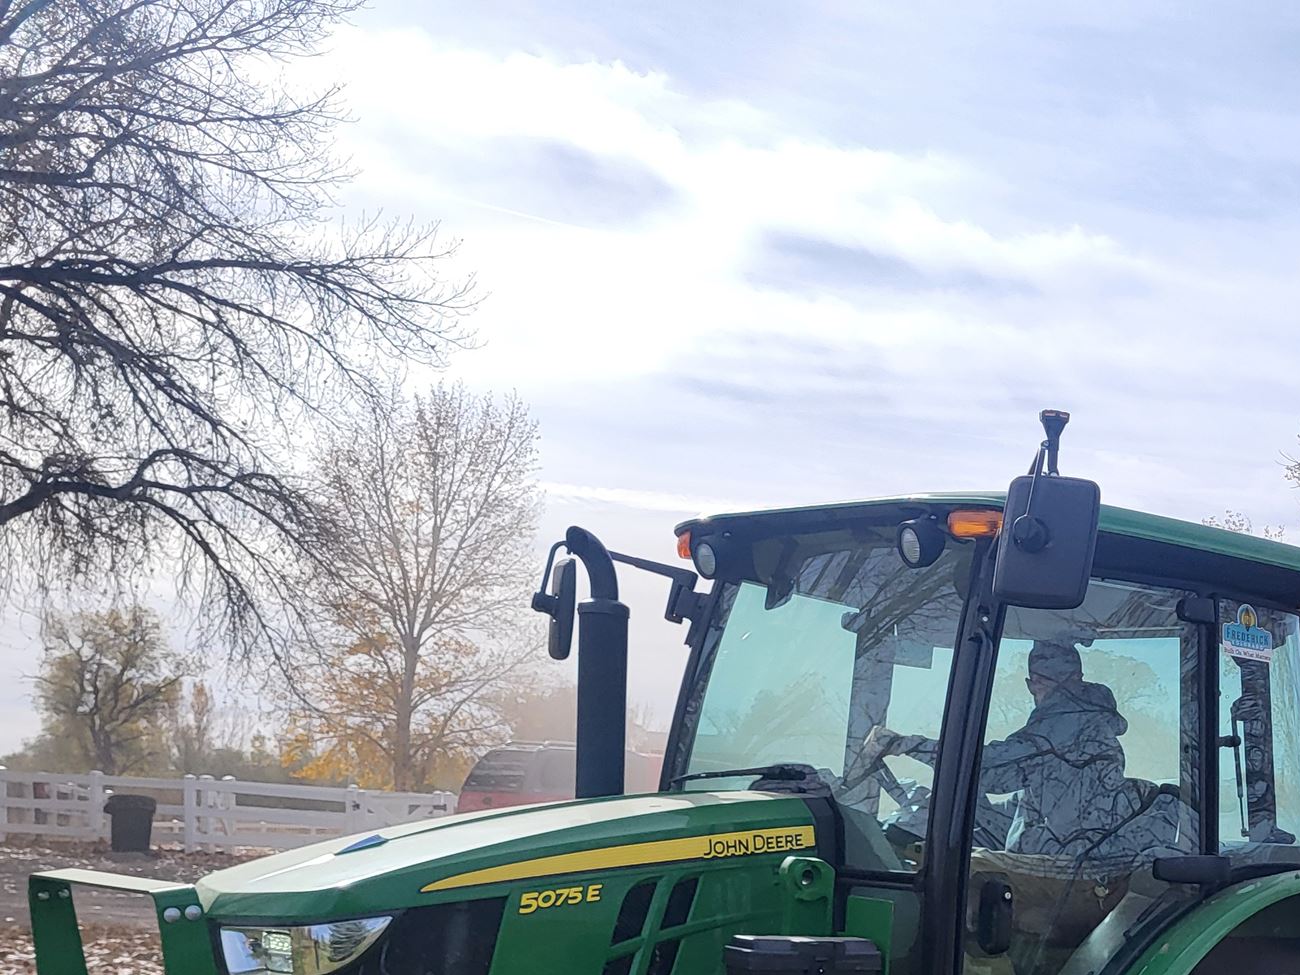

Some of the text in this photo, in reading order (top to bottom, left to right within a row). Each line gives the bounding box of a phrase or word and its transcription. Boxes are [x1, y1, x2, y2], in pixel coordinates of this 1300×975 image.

[1226, 627, 1269, 646] FREDERICK
[704, 834, 804, 857] JOHN DEERE
[518, 884, 603, 914] 5075 E
